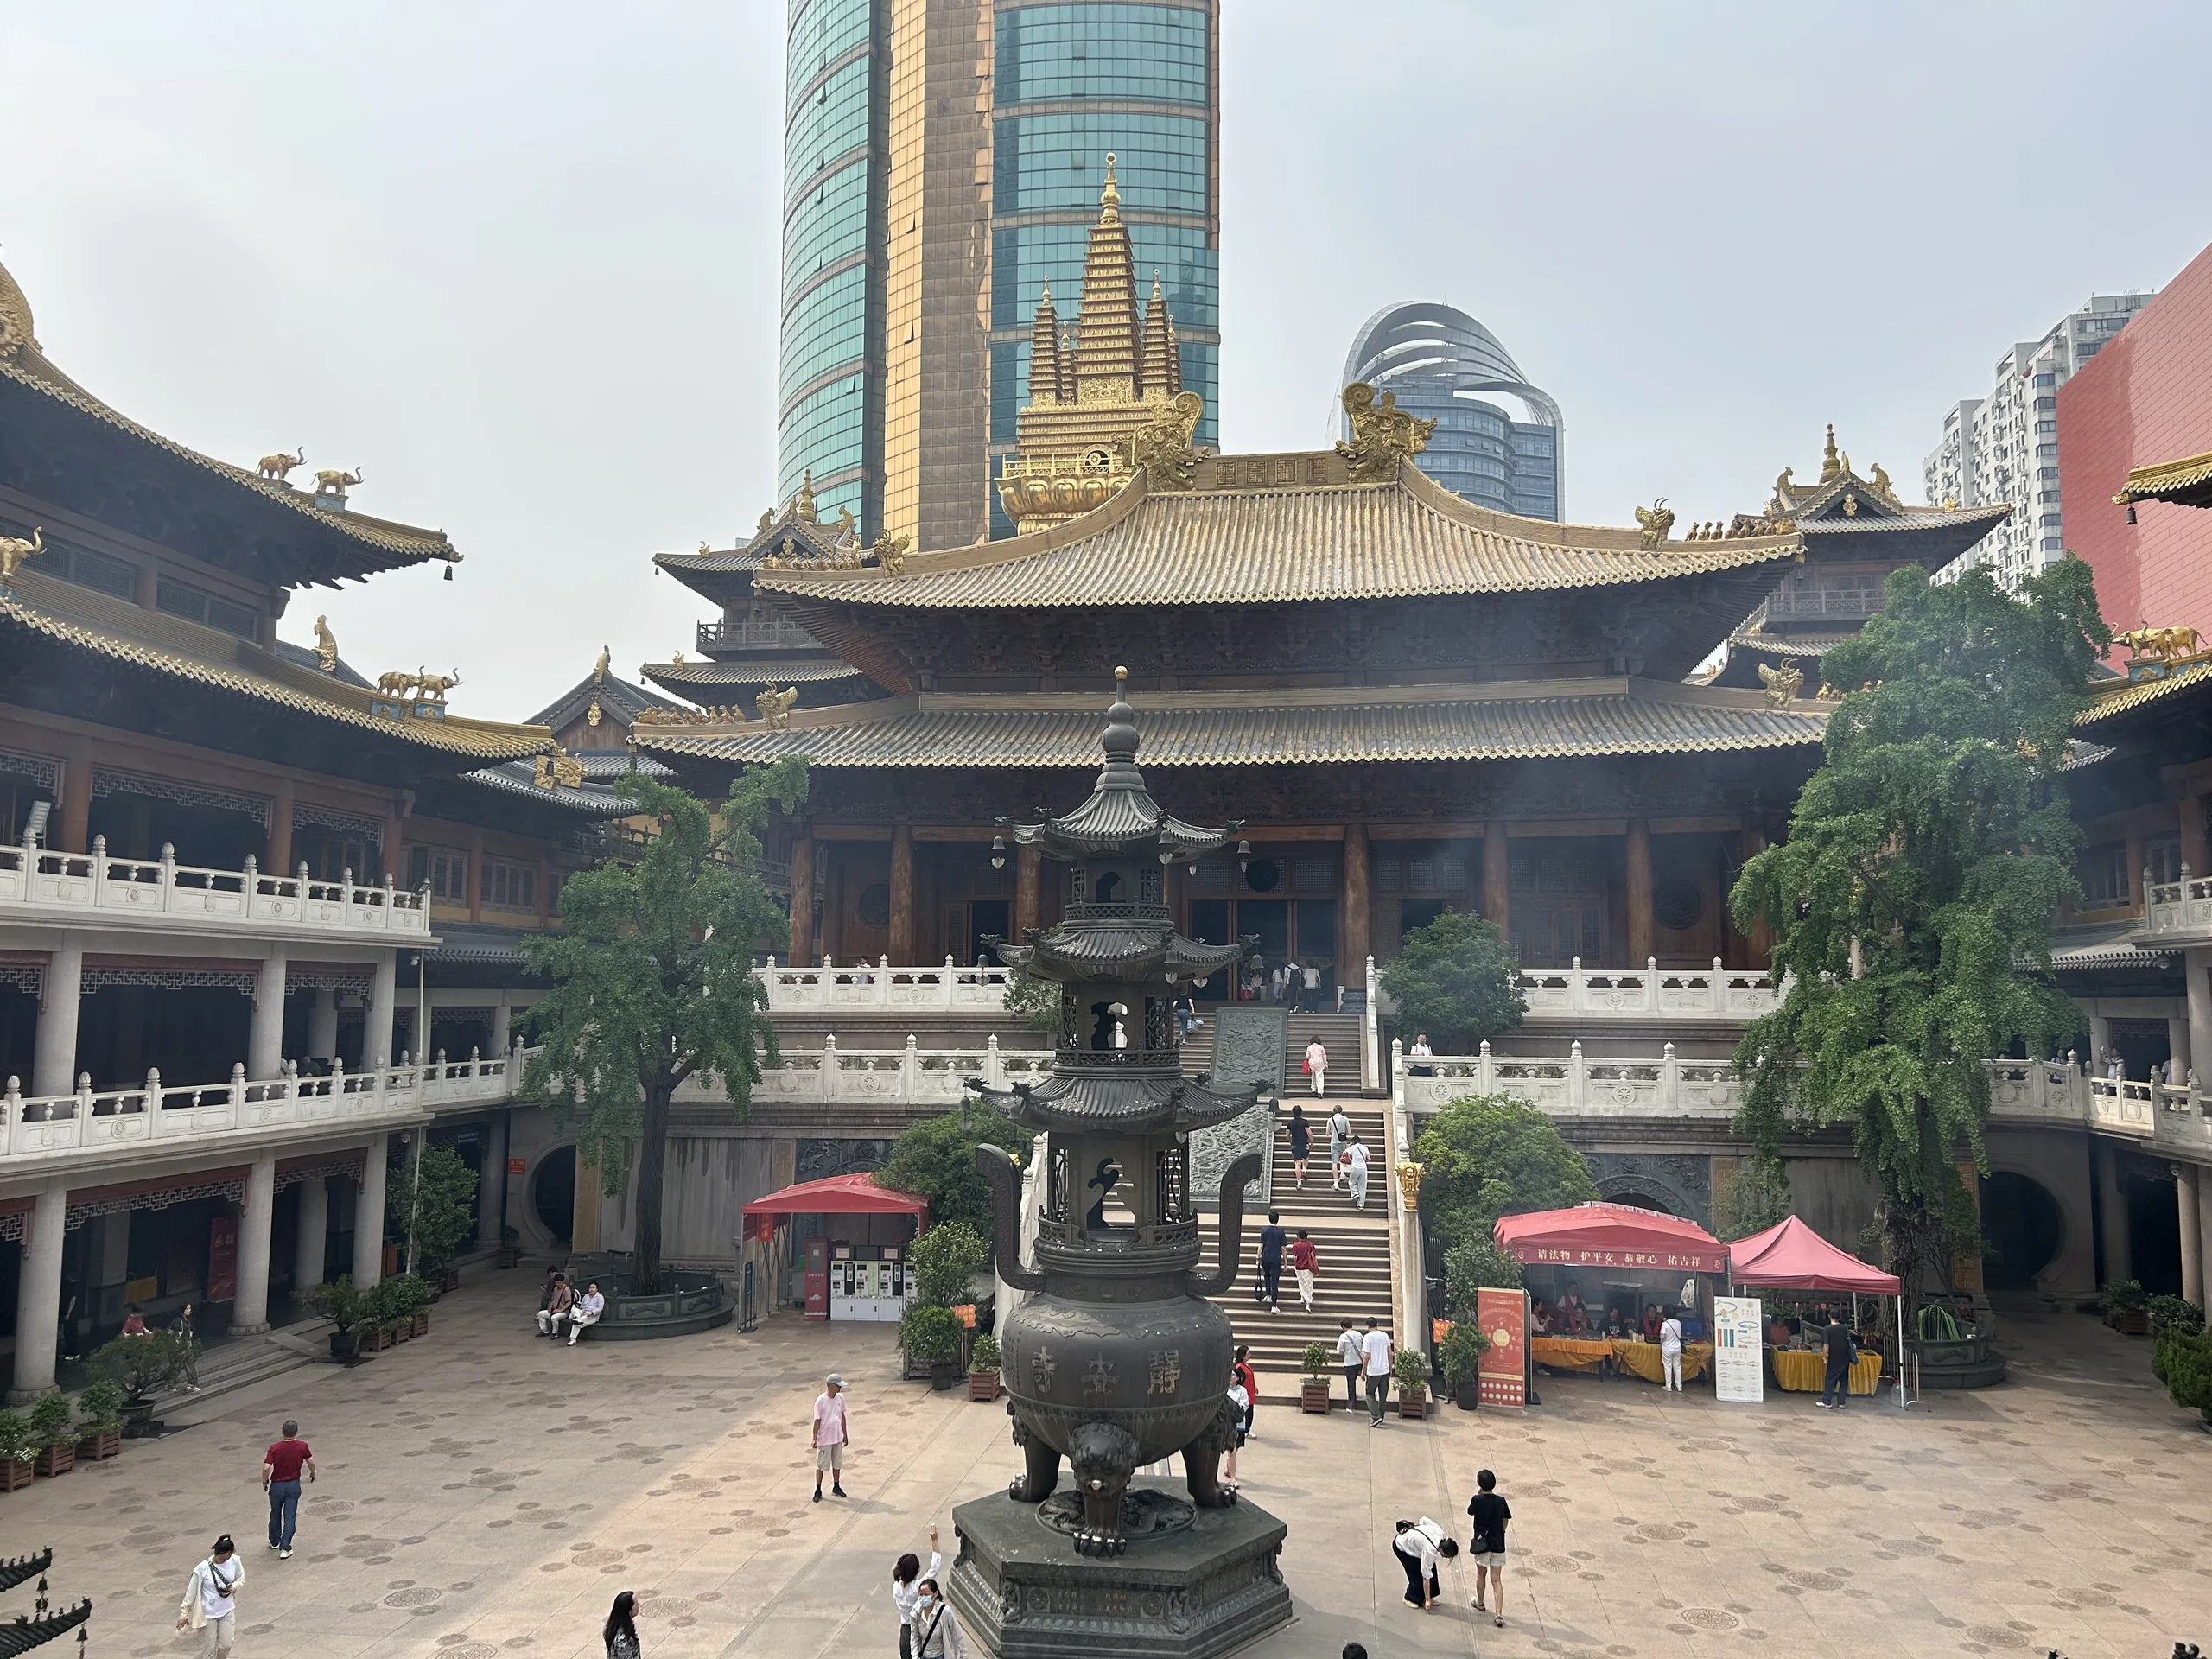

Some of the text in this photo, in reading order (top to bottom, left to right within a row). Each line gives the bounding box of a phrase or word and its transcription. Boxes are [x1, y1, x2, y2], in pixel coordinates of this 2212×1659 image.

[1538, 1249, 1700, 1267] 请法物 护平安 恭敬心 佑吉祥
